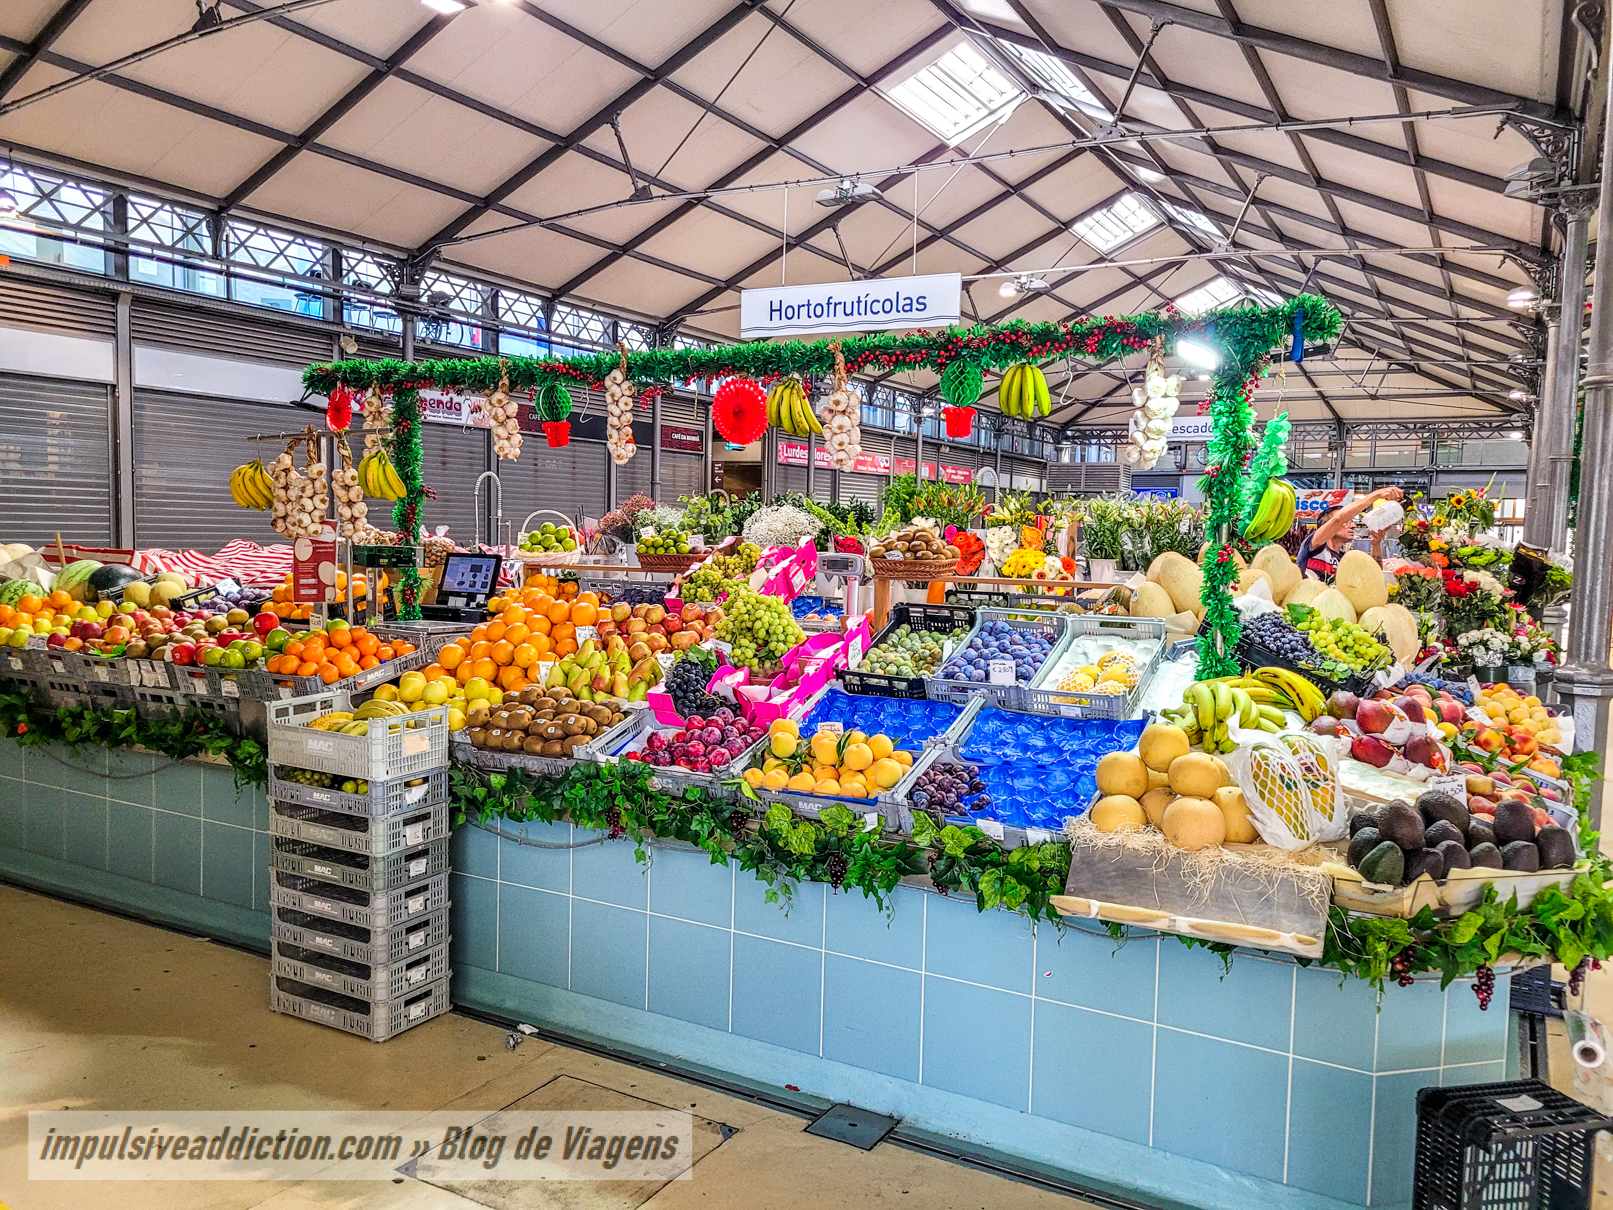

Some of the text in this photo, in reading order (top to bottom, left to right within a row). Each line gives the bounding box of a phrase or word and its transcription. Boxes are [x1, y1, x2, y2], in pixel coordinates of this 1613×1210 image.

[769, 291, 928, 322] Hortofrutícolas
[421, 397, 462, 412] enda
[783, 444, 832, 461] Lurdes lores
[366, 668, 385, 681] MAC
[307, 738, 334, 752] MAC
[312, 792, 331, 801] MAC
[798, 801, 823, 810] MAC
[313, 864, 332, 875] MAC
[313, 900, 332, 910] MAC
[315, 936, 334, 947] MAC
[314, 971, 333, 982] MAC
